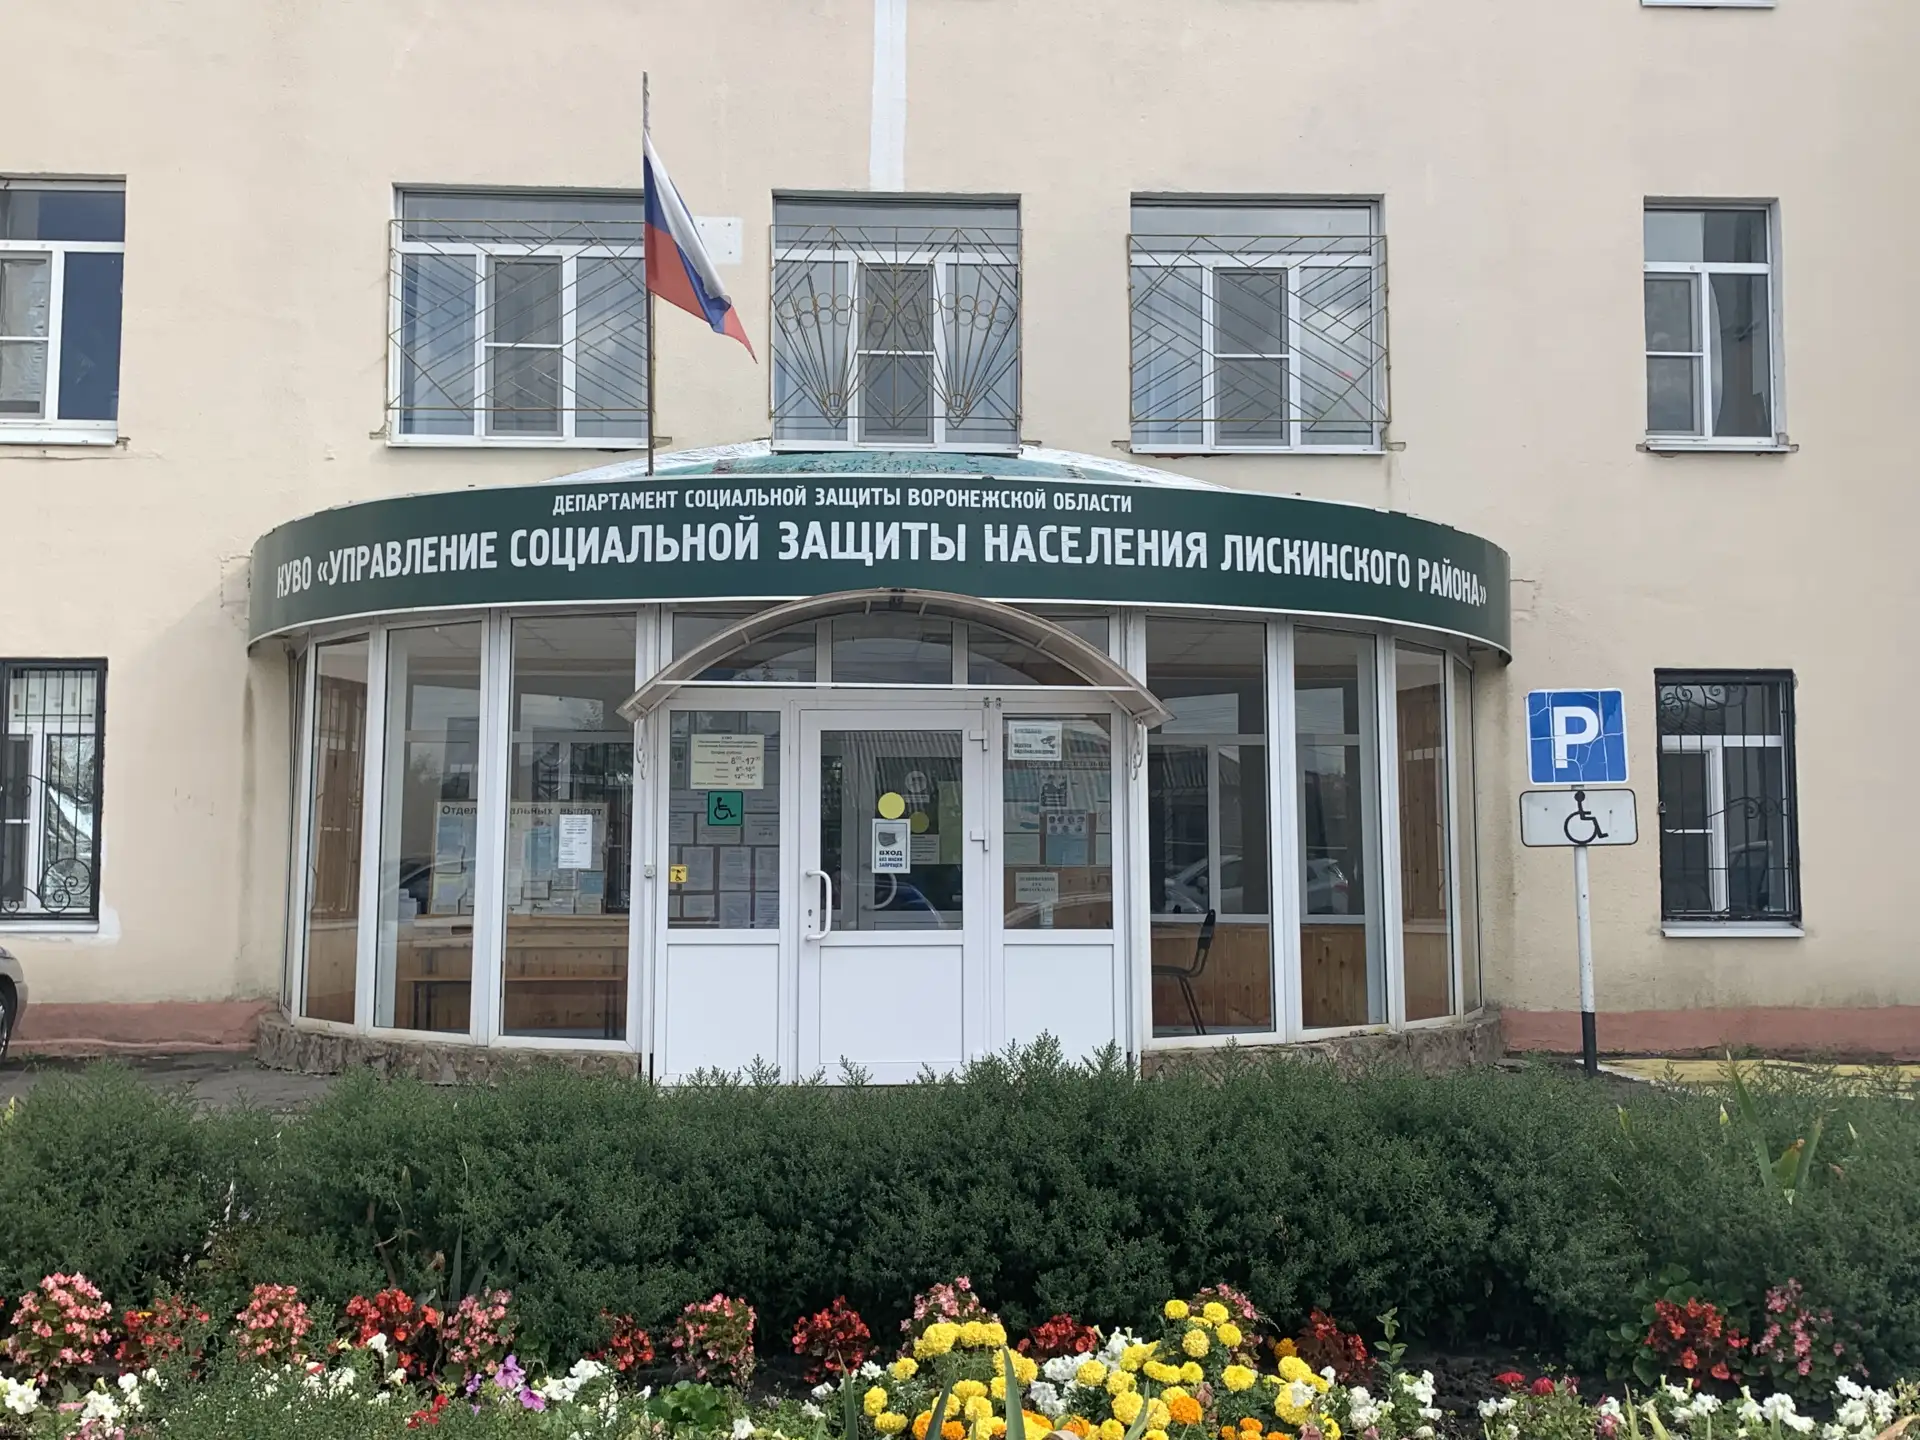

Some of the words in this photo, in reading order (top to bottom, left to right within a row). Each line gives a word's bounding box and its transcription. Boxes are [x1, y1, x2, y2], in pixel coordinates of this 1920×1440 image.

[552, 490, 679, 516] ДЕПАРТАМЕНТ
[684, 485, 807, 510] СОЦИАЛЬНОЙ
[814, 487, 901, 509] ЗАЩИТЫ
[907, 487, 1047, 510] ВОРОНЕЖСКОЙ
[1053, 492, 1132, 513] ОБЛАСТИ
[276, 556, 312, 599] КУВО
[316, 531, 498, 586] «УПРАВЛЕНИЕ
[509, 514, 760, 572] СОЦИАЛЬНОЙ
[777, 520, 967, 567] ЗАЩИТЫ
[983, 523, 1208, 569] НАСЕЛЕНИЯ
[1220, 534, 1410, 589] ЛИСКИНСКОГО
[1417, 557, 1488, 607] РАЙОНА»
[1553, 706, 1599, 769] P
